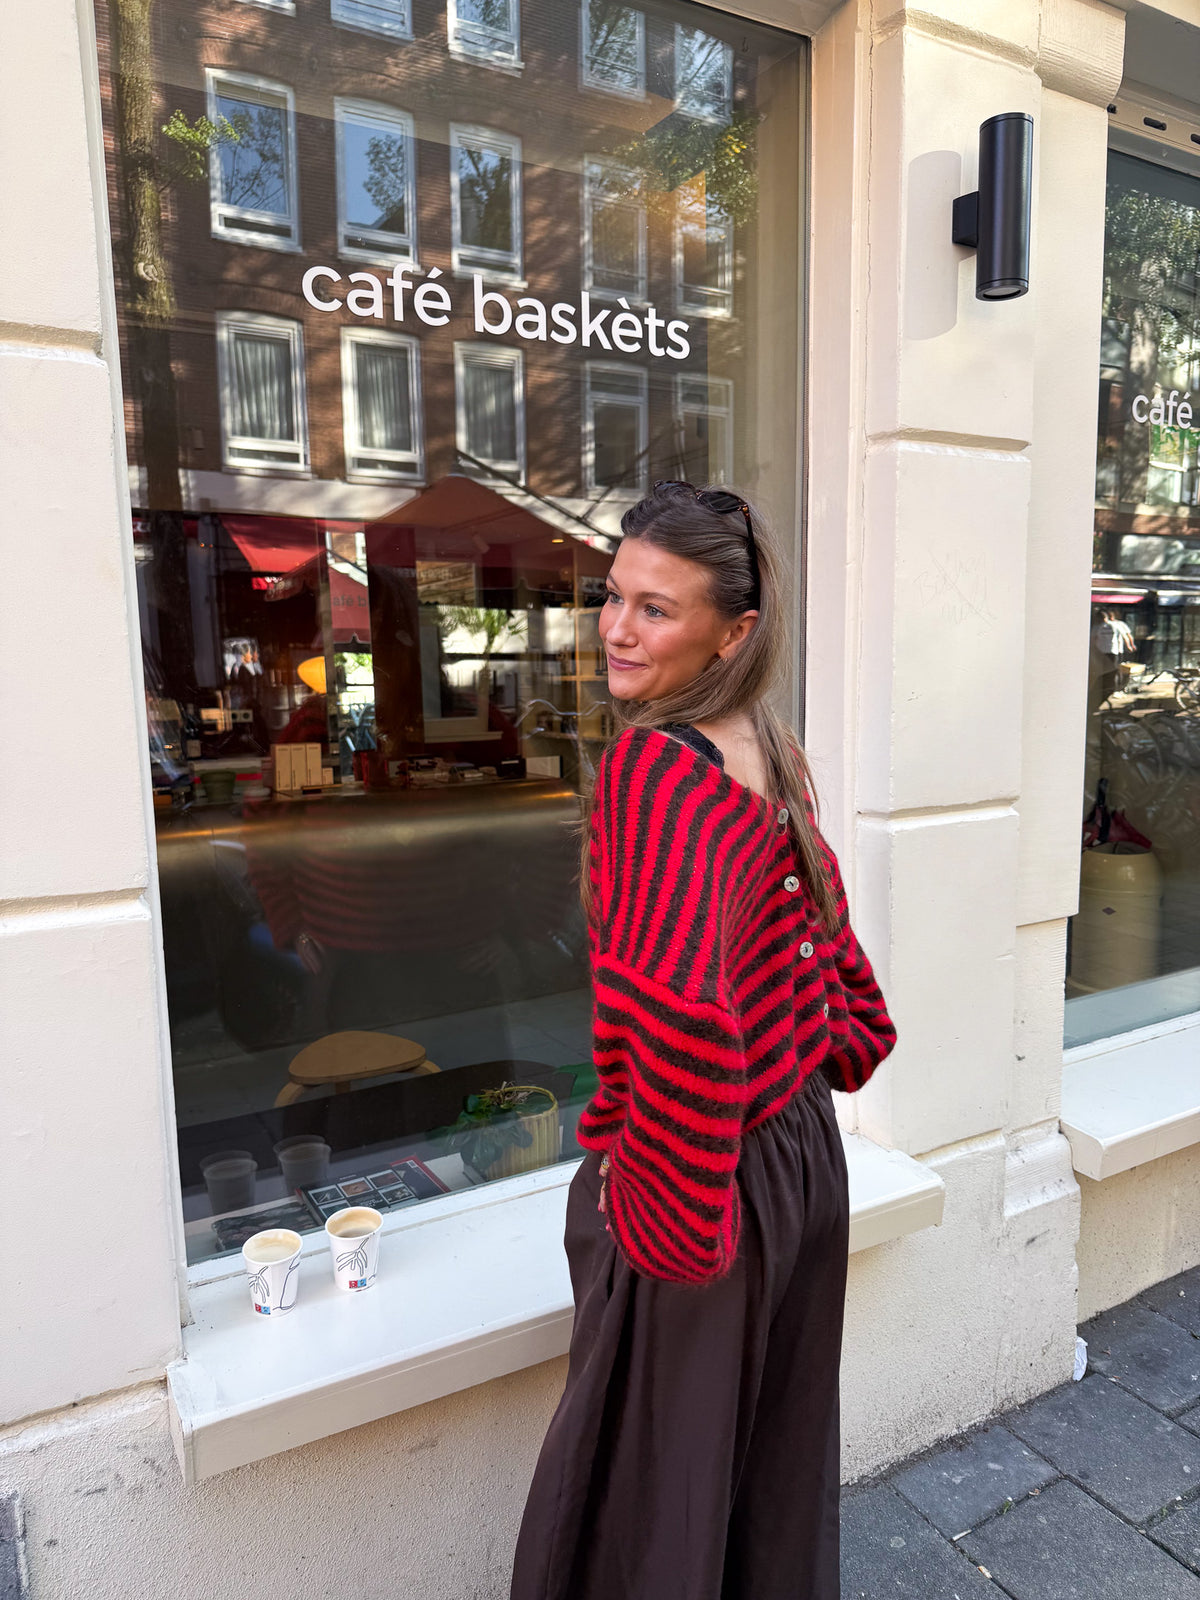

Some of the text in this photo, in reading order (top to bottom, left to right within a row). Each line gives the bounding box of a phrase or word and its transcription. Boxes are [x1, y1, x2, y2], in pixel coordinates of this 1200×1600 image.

[301, 262, 692, 361] café baskèts
[1132, 390, 1193, 429] café
[333, 594, 354, 607] afé
